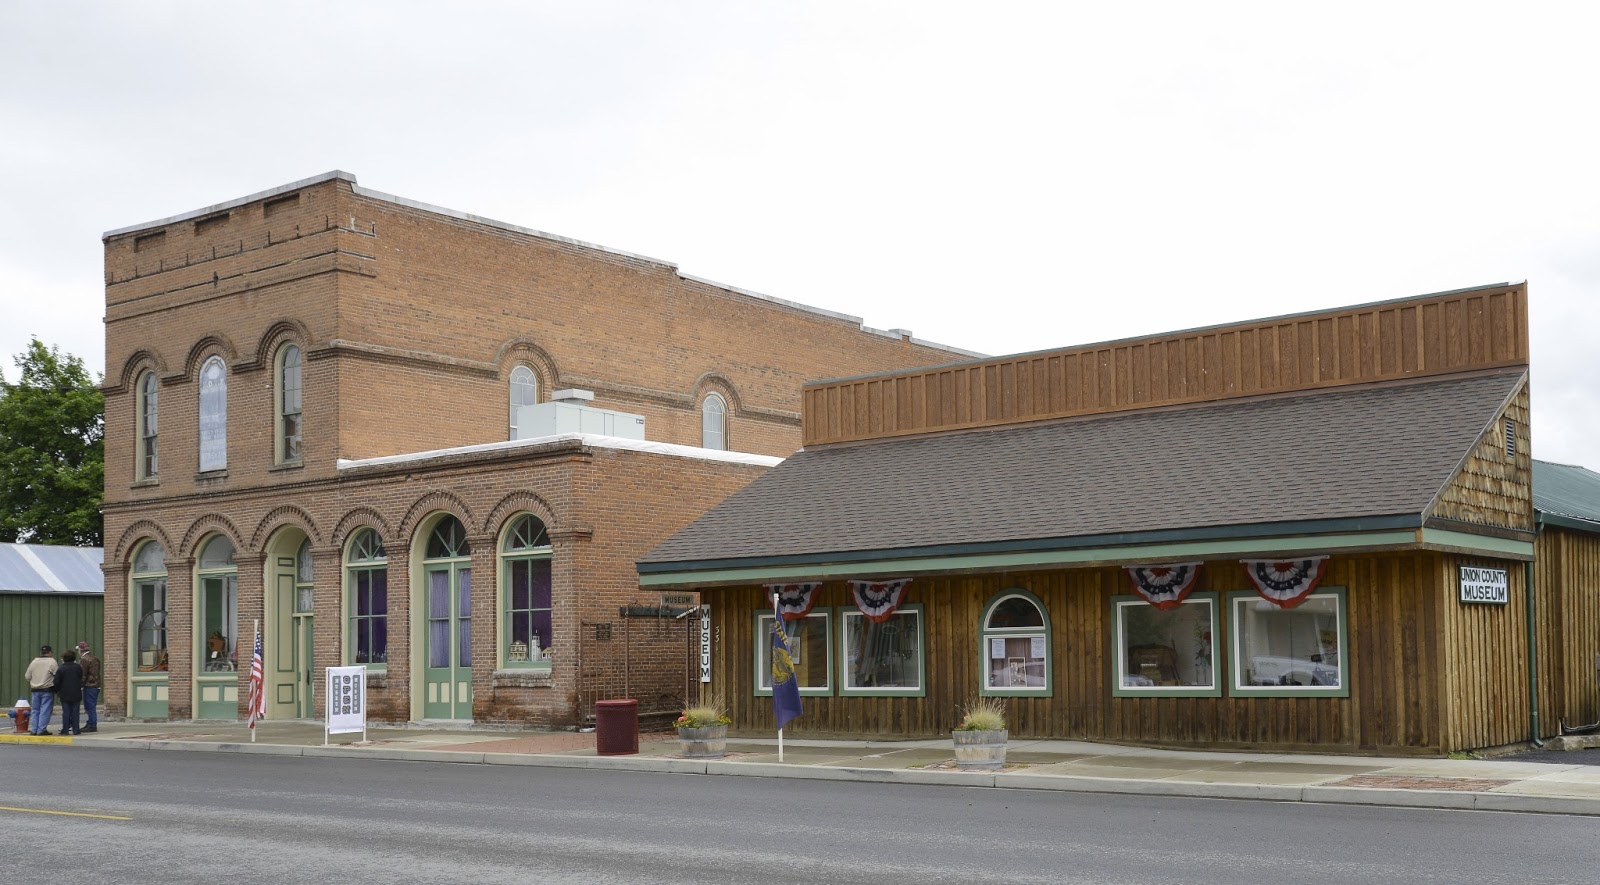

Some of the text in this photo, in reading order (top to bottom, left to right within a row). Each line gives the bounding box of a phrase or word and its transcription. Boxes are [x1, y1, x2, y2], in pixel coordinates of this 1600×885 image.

[1461, 568, 1506, 584] UNION COUNTY
[1464, 585, 1504, 600] MUSEUM
[702, 608, 710, 678] MUSEUM
[774, 620, 788, 646] STATE
[342, 676, 351, 714] OPEN
